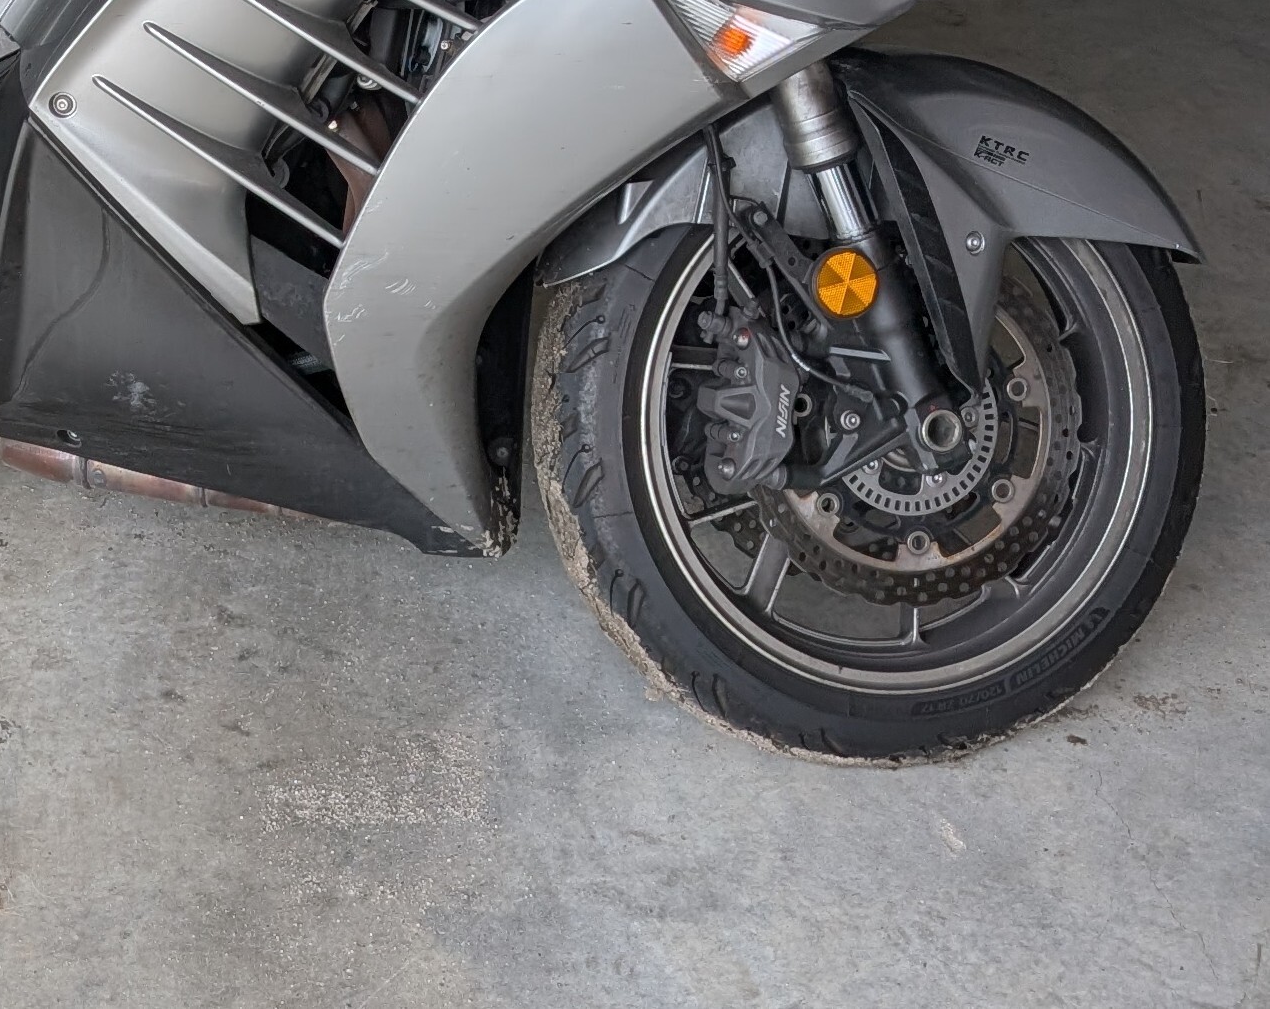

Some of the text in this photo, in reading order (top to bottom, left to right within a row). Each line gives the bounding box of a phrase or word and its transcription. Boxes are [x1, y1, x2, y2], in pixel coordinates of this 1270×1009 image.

[973, 150, 1005, 167] K-ACT
[979, 135, 1030, 162] KTRC
[775, 383, 791, 438] NISSIN
[1015, 626, 1085, 685] MICHELIN
[959, 684, 1003, 707] 120/70
